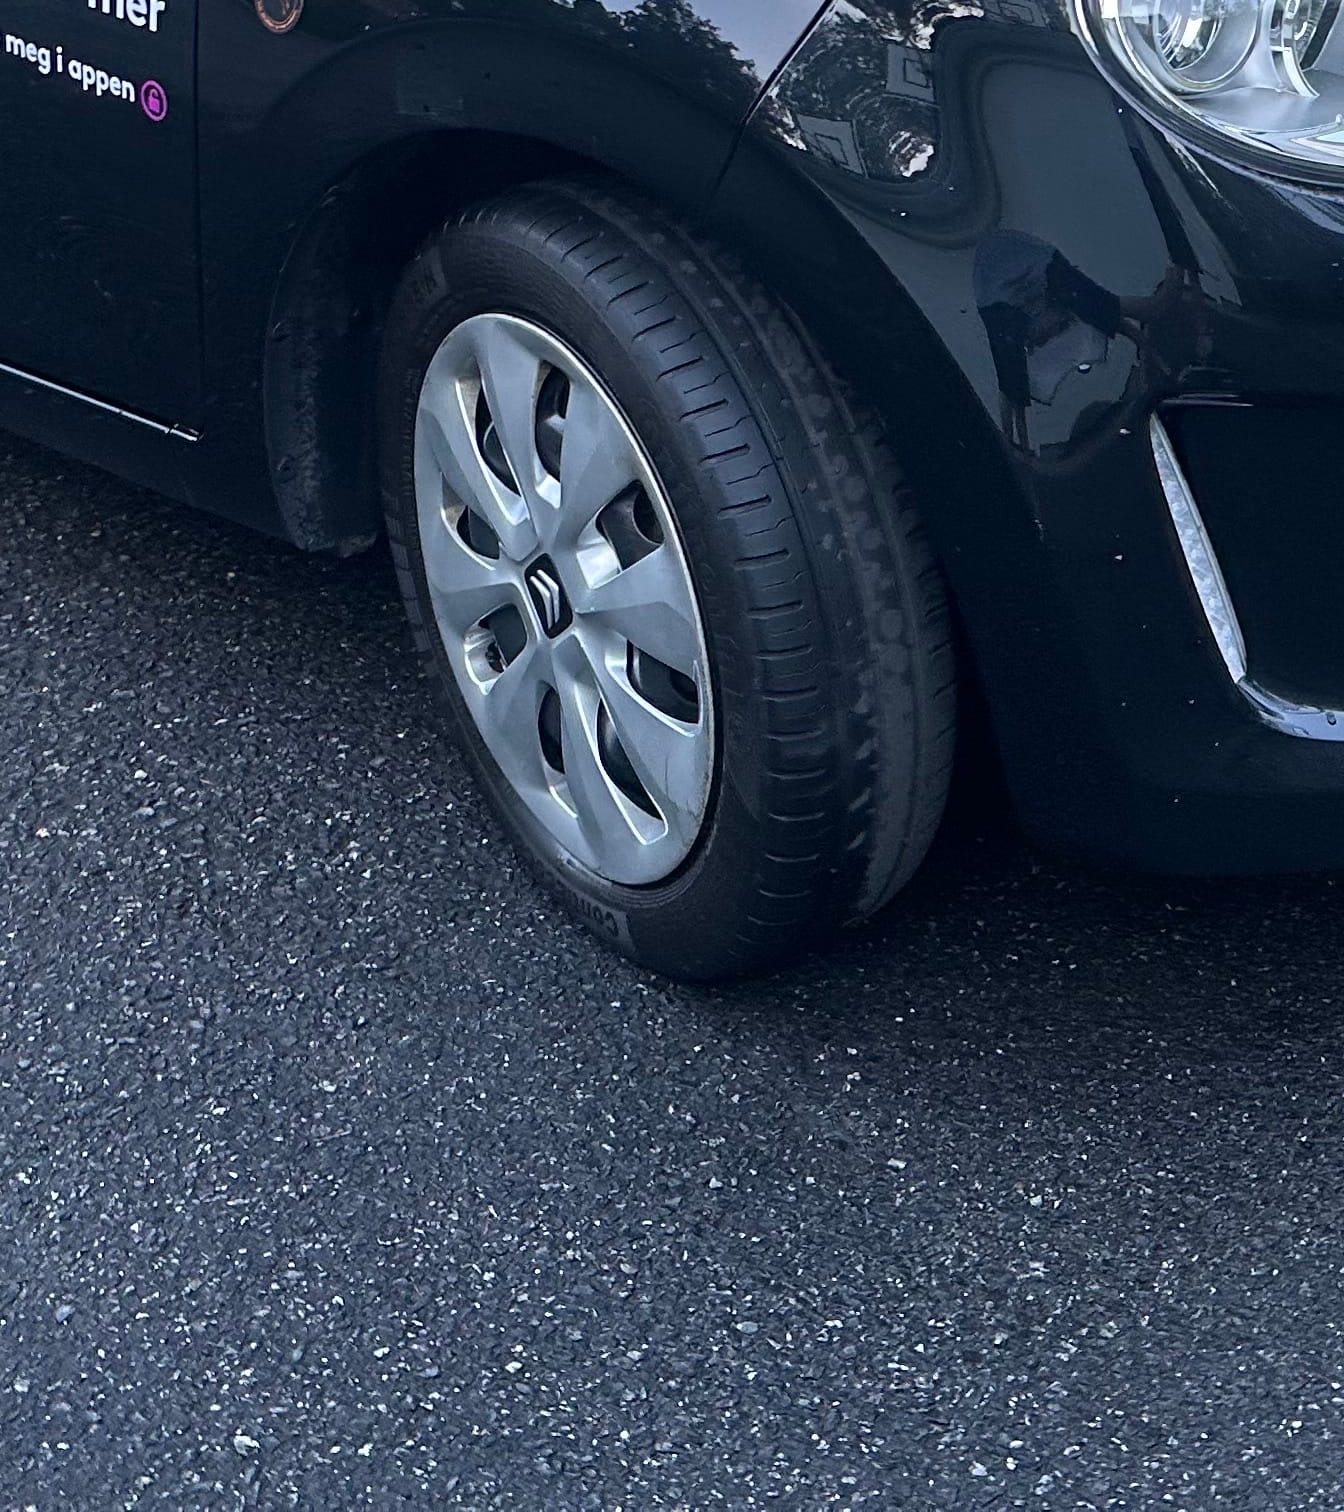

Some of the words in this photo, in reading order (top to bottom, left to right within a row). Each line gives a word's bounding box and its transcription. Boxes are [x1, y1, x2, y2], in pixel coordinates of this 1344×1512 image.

[5, 34, 52, 75] meg
[55, 45, 64, 73] i
[67, 57, 136, 102] appen
